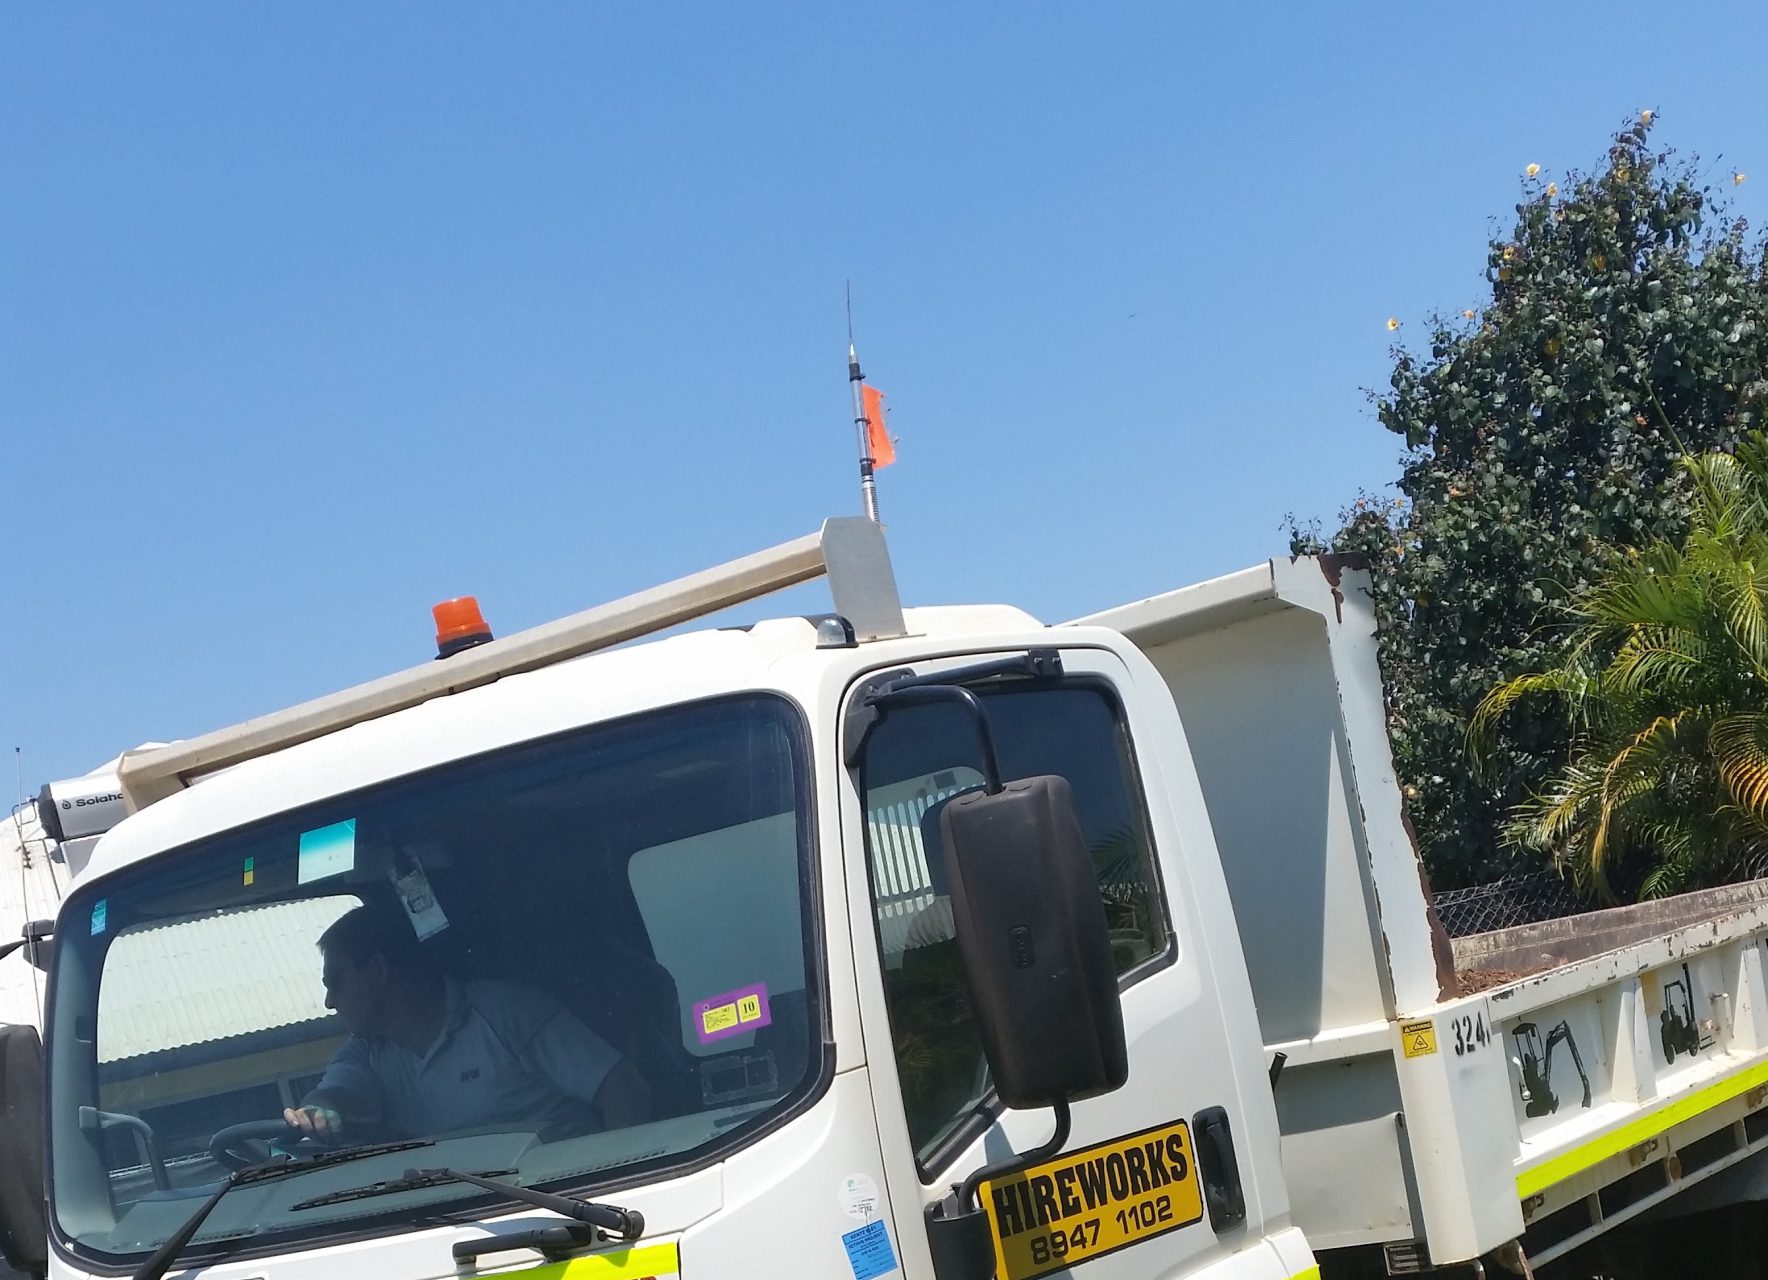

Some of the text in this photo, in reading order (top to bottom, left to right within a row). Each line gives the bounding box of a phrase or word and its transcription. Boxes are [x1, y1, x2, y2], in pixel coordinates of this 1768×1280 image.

[743, 1001, 755, 1014] 10
[991, 1134, 1188, 1239] HIREWORKS
[1031, 1195, 1174, 1265] 8947 1102
